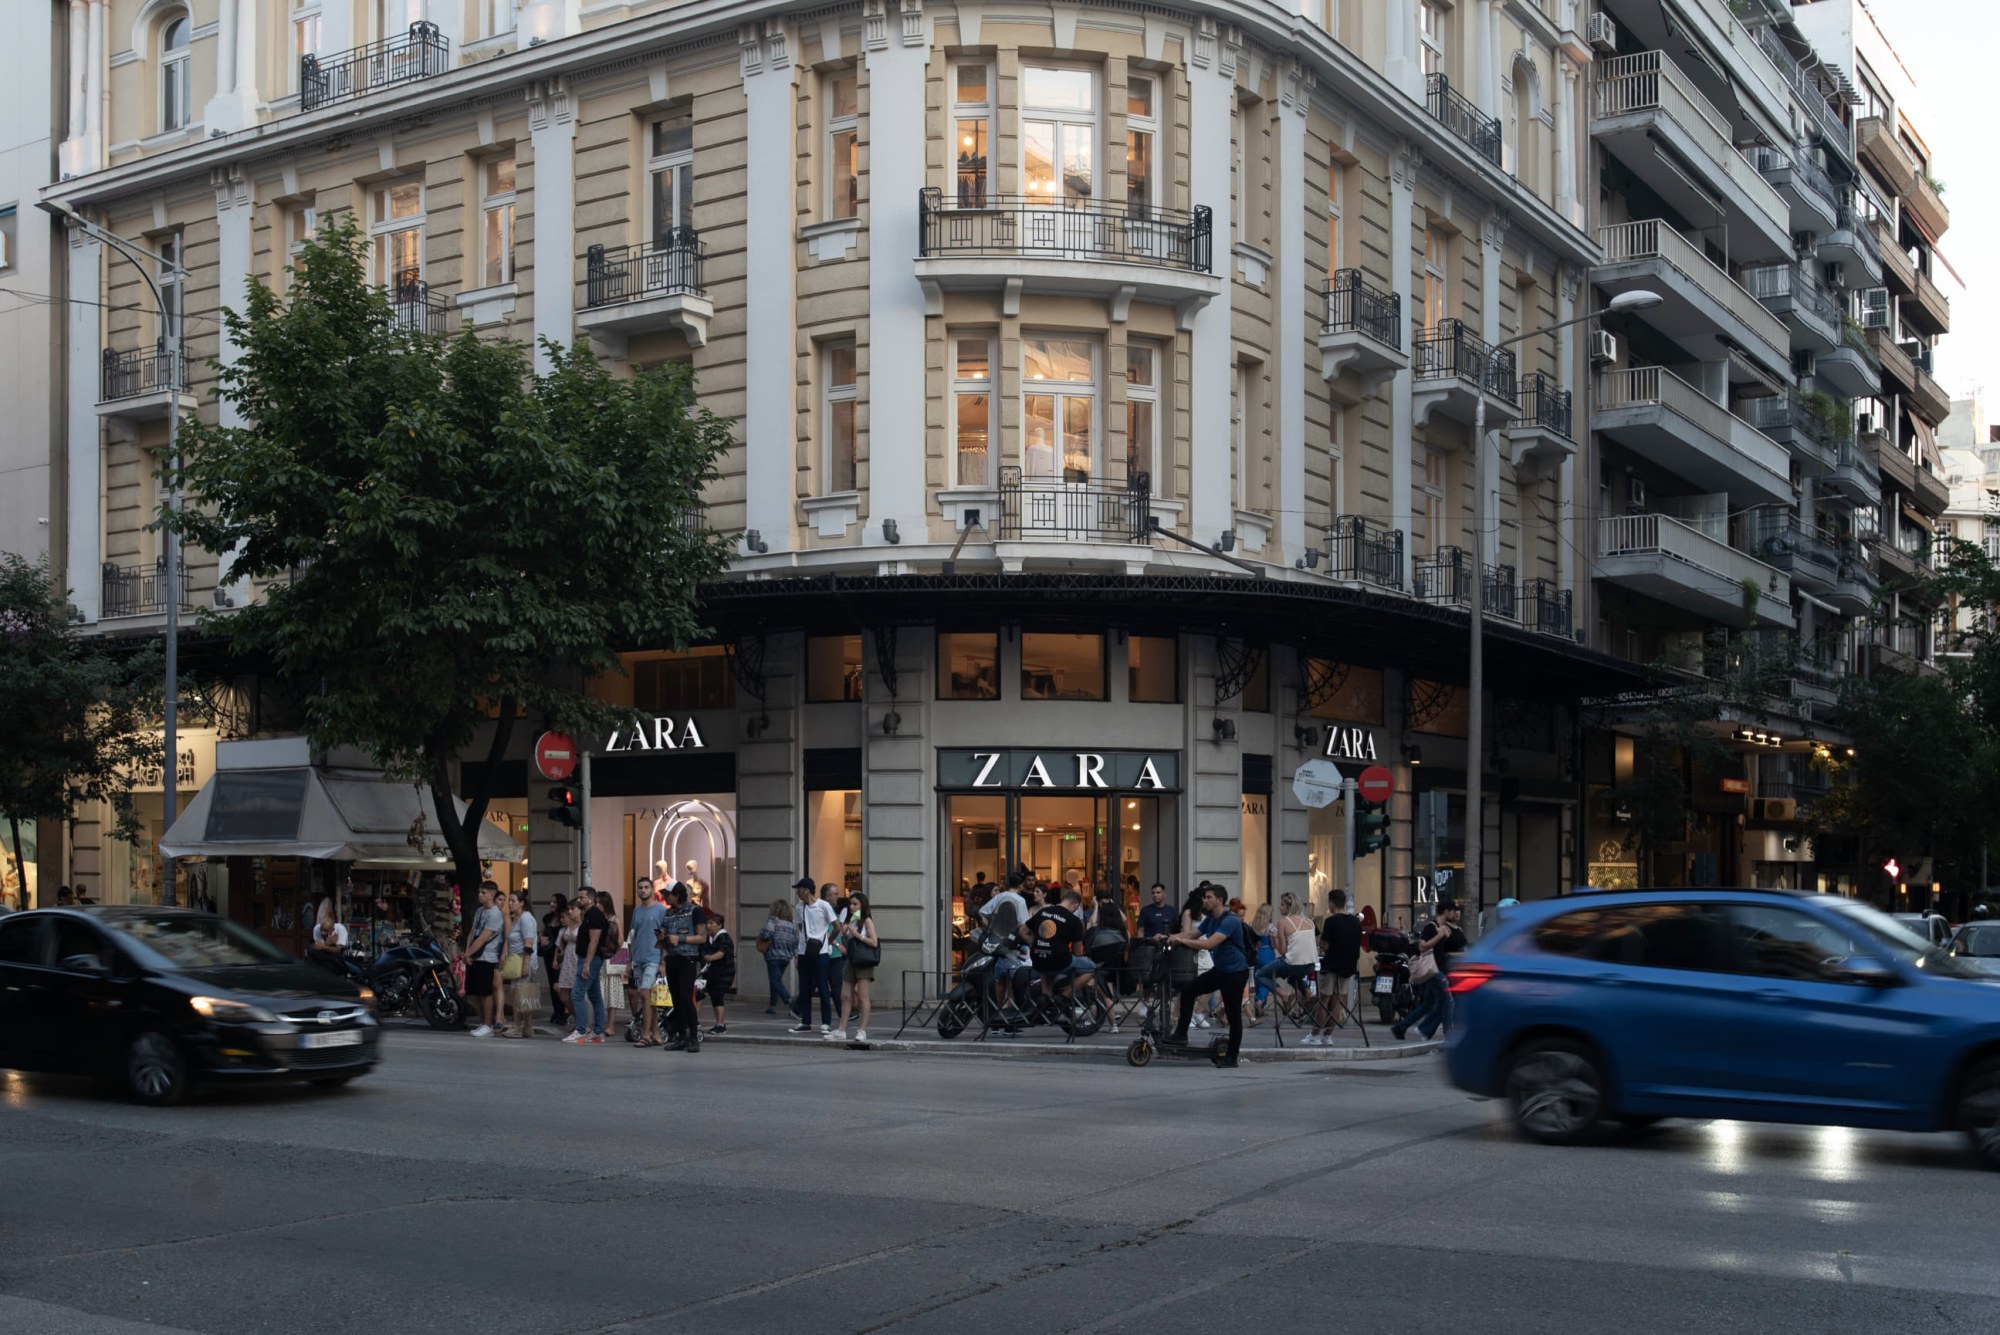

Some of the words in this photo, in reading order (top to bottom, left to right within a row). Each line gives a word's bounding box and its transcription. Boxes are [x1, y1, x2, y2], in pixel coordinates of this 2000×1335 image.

[605, 716, 705, 752] ZARA
[1326, 725, 1378, 760] ZARA
[972, 753, 1166, 789] ZARA
